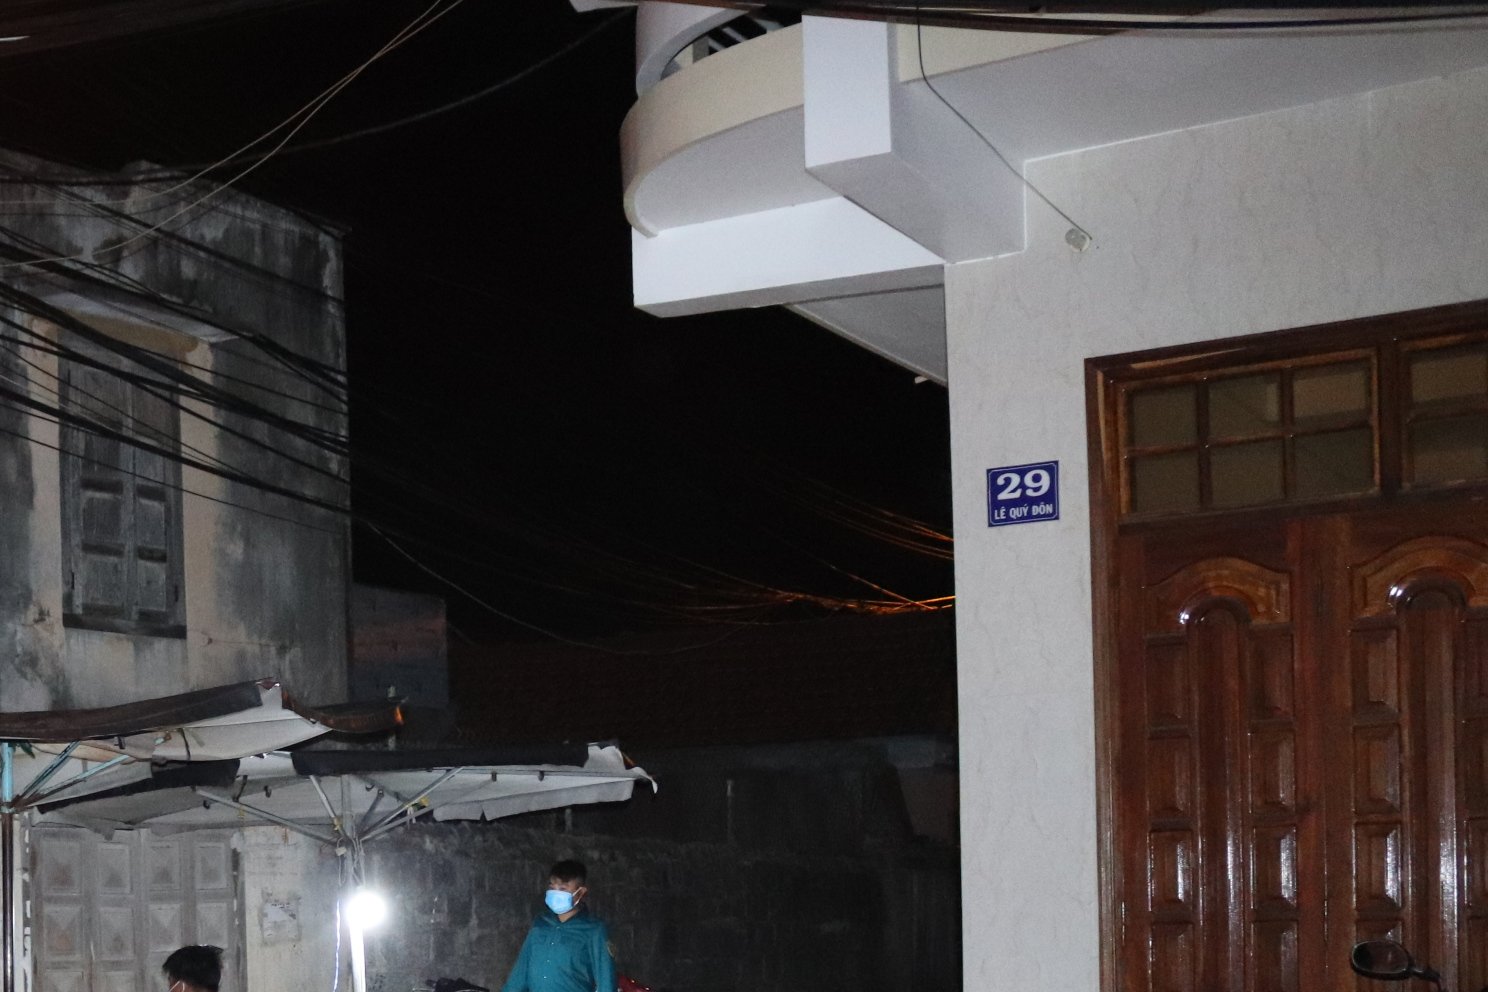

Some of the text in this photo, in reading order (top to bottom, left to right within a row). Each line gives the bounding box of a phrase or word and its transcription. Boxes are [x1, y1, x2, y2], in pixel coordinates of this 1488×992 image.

[996, 469, 1051, 500] 29
[994, 502, 1053, 520] LÊ QUÝ ĐÔN
